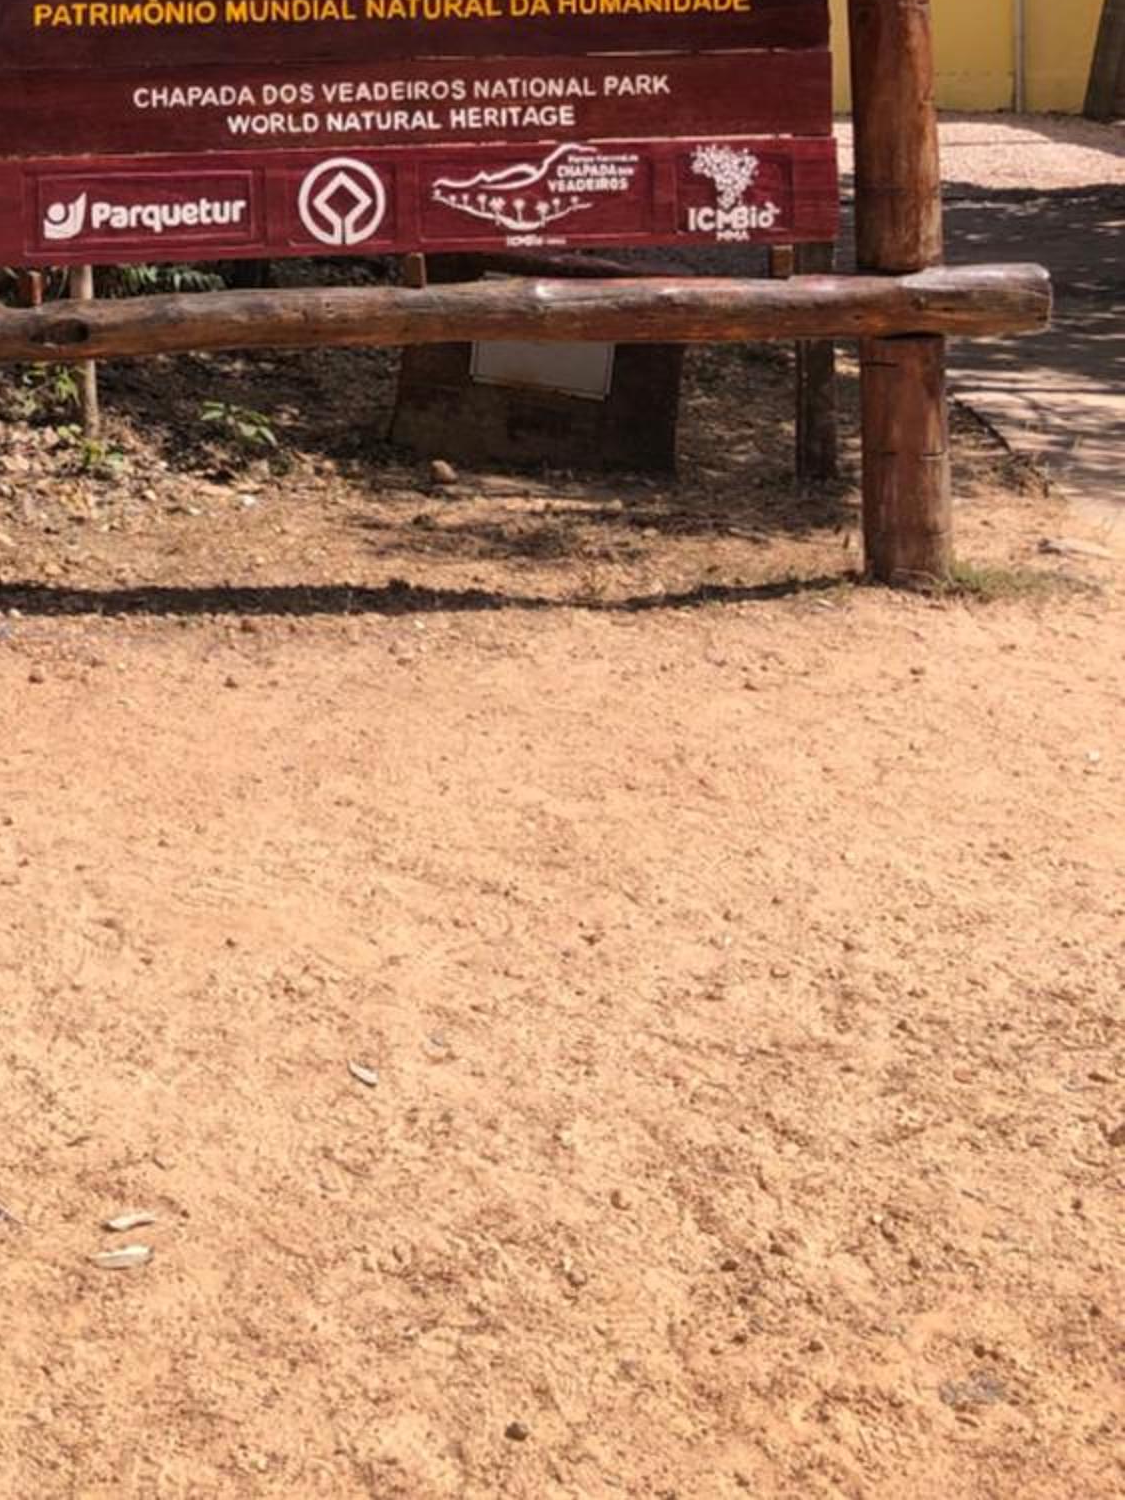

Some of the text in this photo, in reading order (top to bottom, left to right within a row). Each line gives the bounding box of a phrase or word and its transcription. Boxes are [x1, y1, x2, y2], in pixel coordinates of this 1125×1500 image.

[133, 74, 671, 109] CHAPADA DOS VEADEIROS NATIONAL PARK
[227, 104, 576, 135] WORLD NATURAL HERITAGE
[547, 177, 629, 193] VEADEIROS
[91, 197, 246, 233] Parquetur
[688, 202, 780, 232] ICMBio
